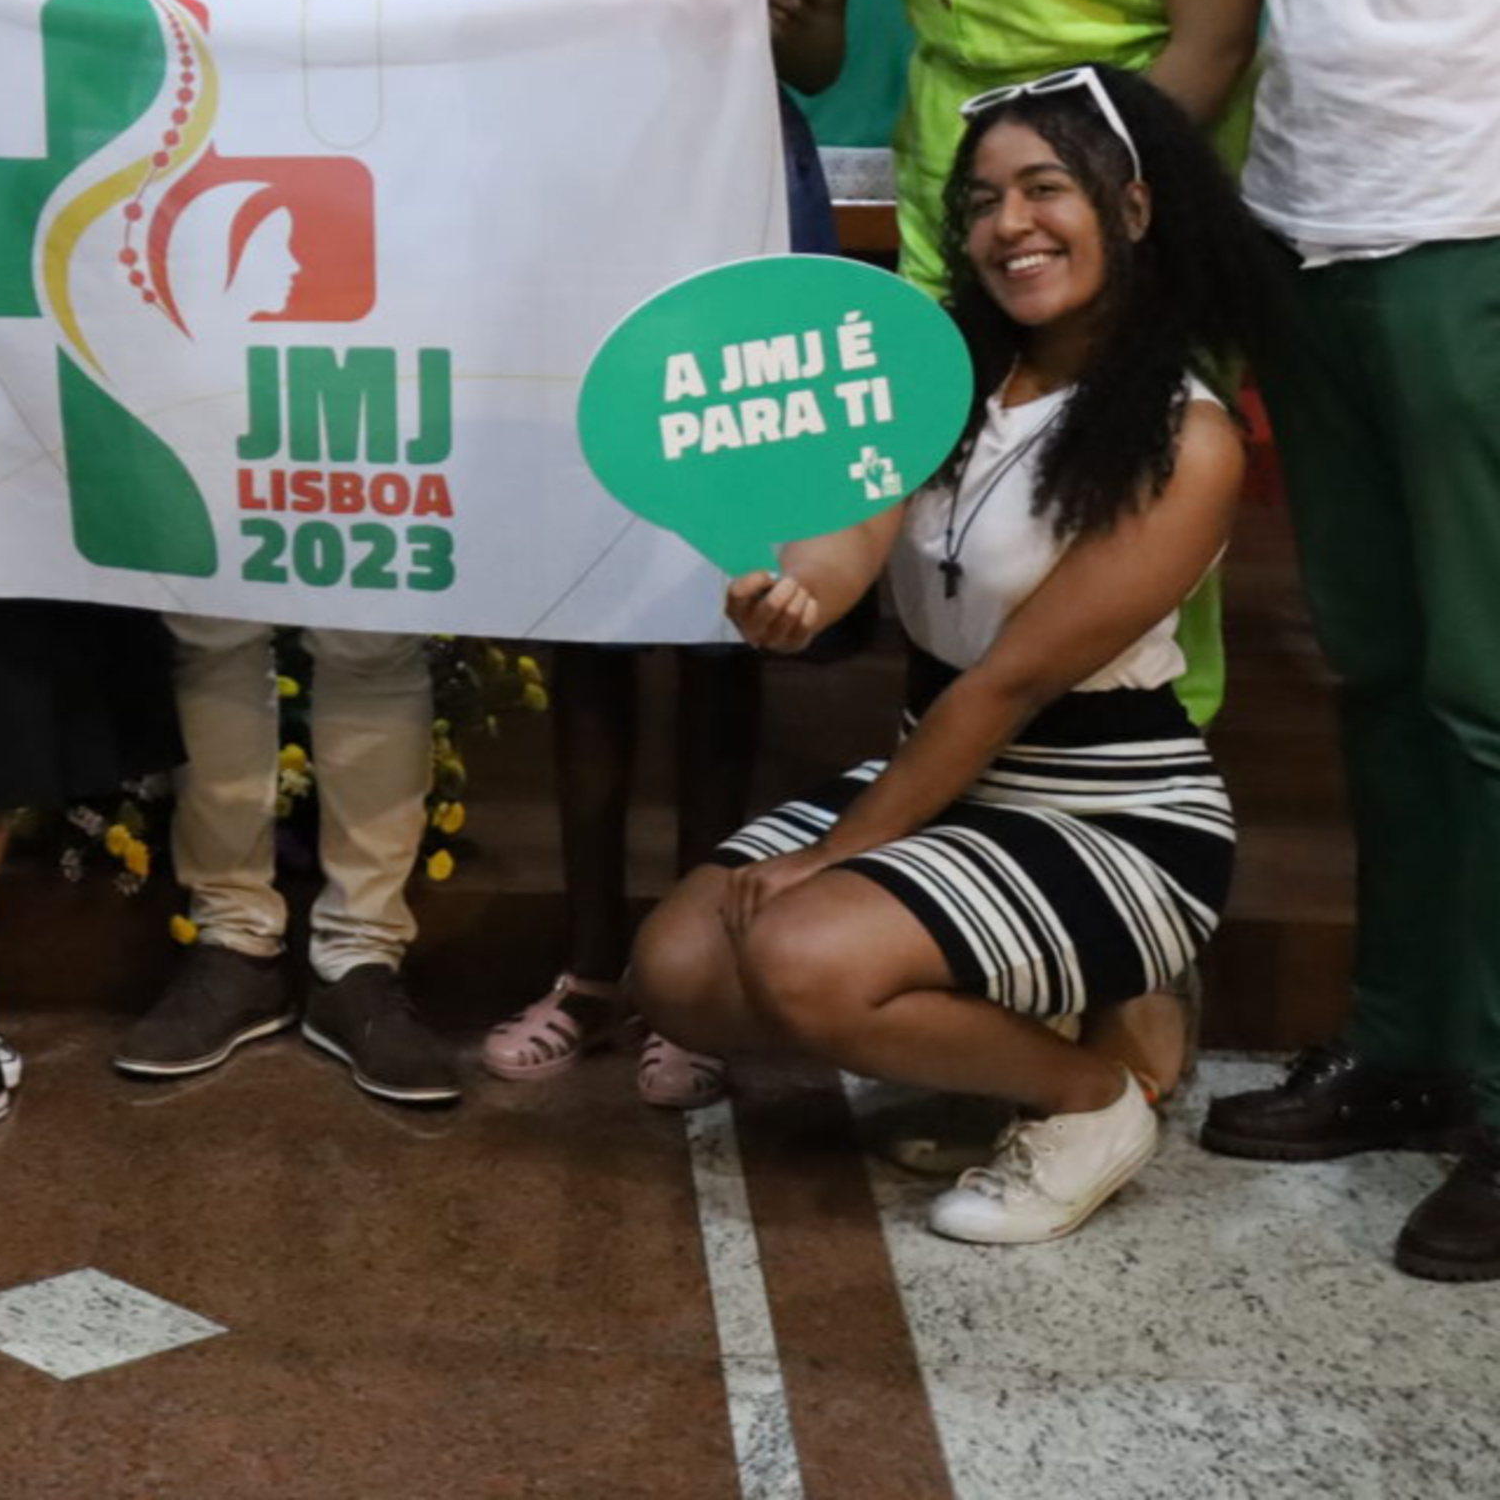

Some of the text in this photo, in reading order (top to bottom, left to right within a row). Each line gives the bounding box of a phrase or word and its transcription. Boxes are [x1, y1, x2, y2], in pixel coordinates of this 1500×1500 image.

[664, 310, 878, 403] A JMJ É
[236, 345, 453, 465] JMJ
[659, 376, 894, 461] PARA TI
[237, 468, 455, 518] LISBOA
[240, 517, 456, 592] 2023
